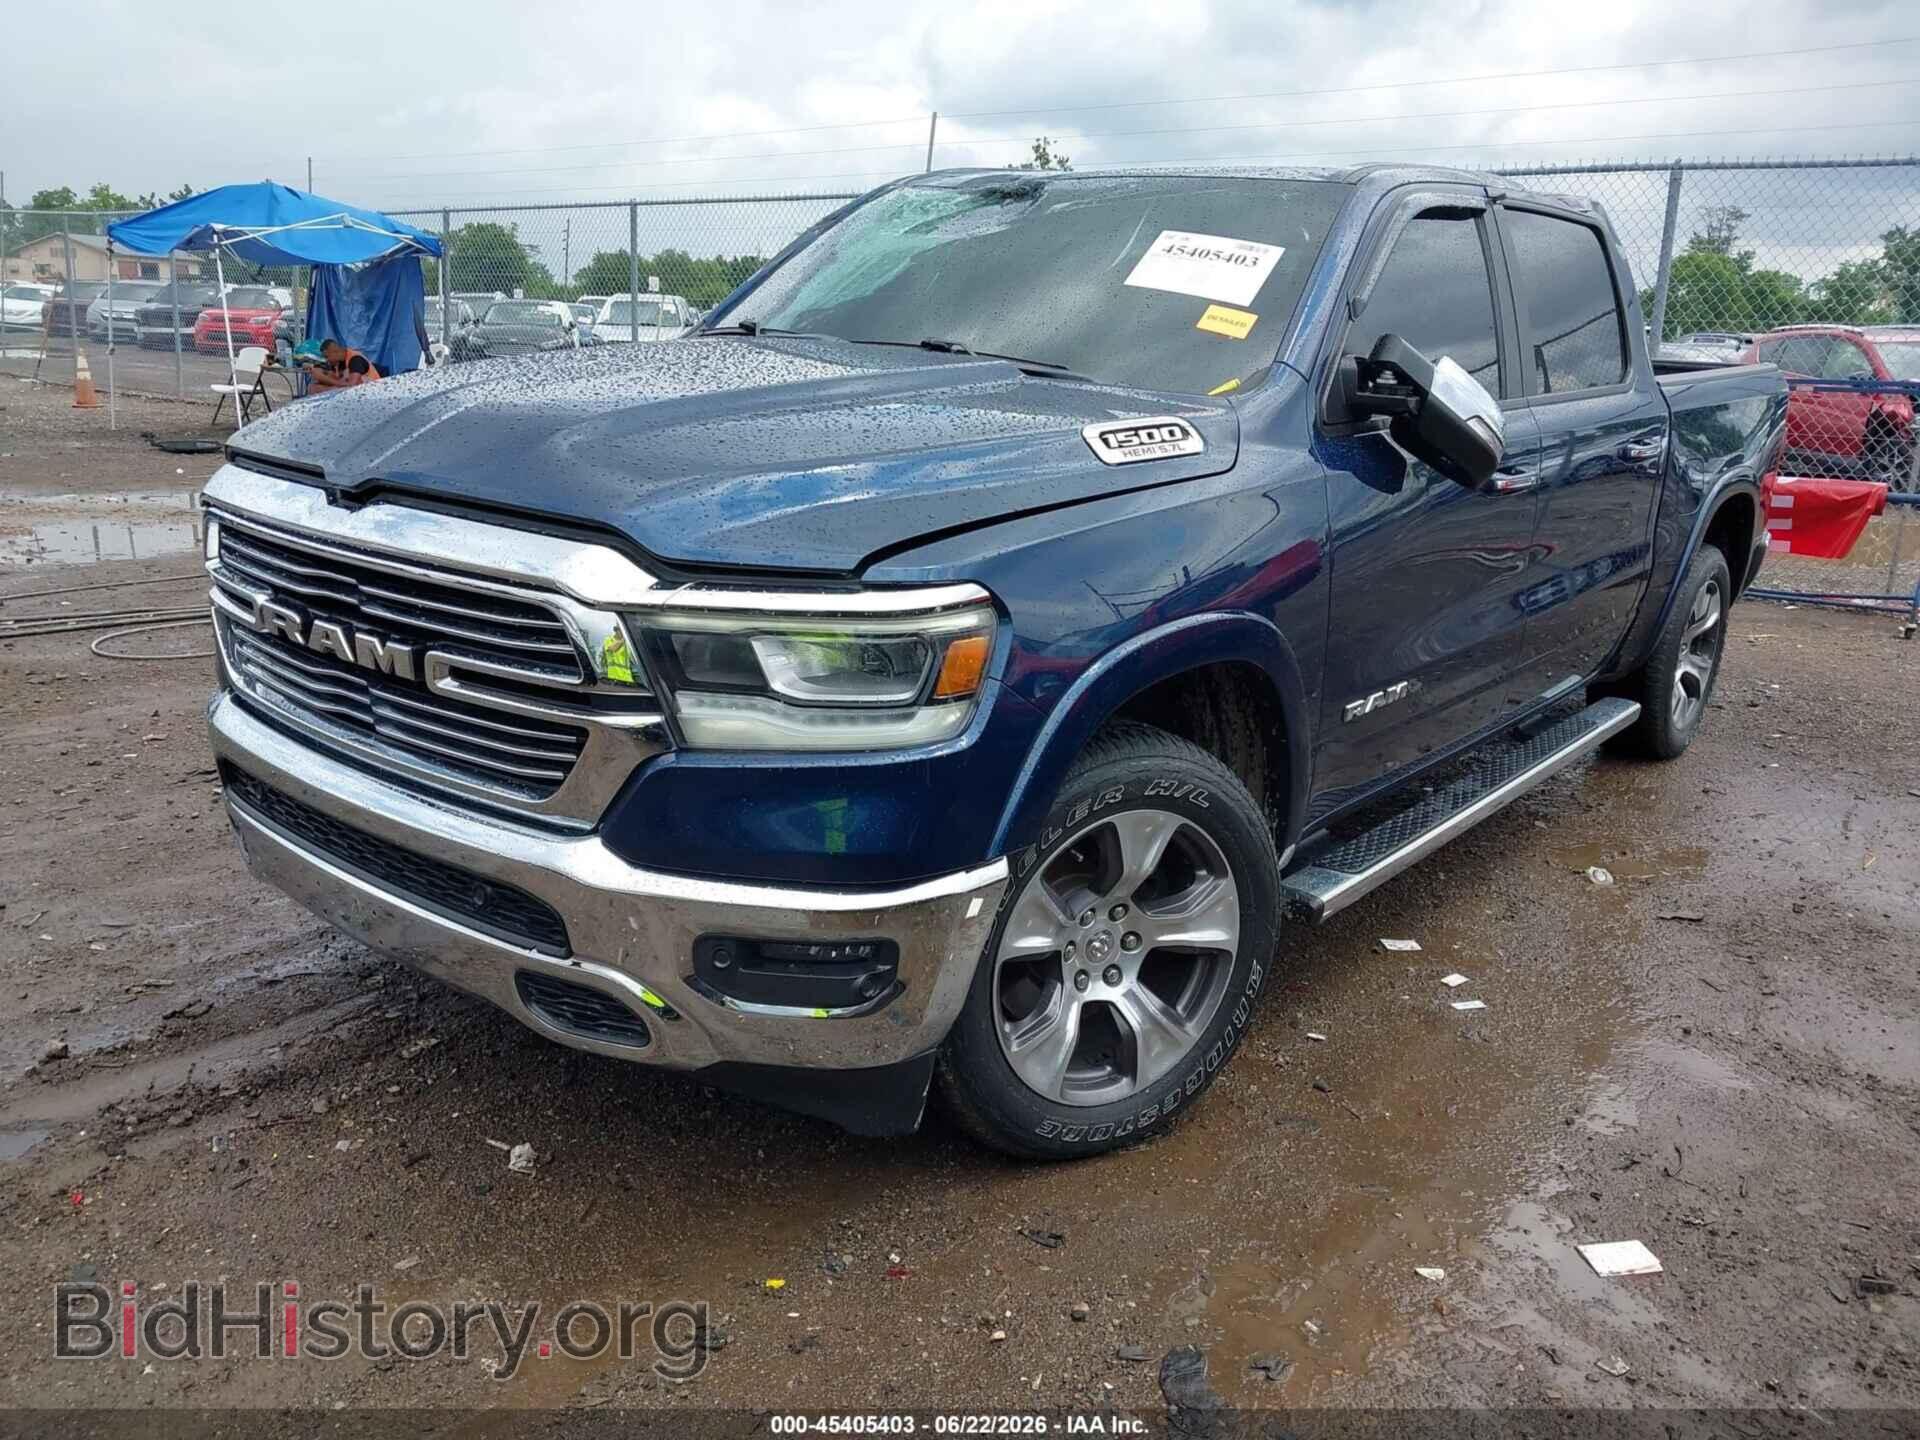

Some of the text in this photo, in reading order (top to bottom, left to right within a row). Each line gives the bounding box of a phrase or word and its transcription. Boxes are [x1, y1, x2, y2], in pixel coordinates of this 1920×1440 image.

[1162, 243, 1260, 268] 45405403
[1101, 425, 1184, 449] 1500
[1122, 443, 1186, 458] HEMI 5.7L
[260, 600, 416, 681] RAM
[1343, 681, 1408, 722] RAM
[1144, 778, 1212, 808] H/L
[1034, 959, 1264, 1142] BRIDGESTONE
